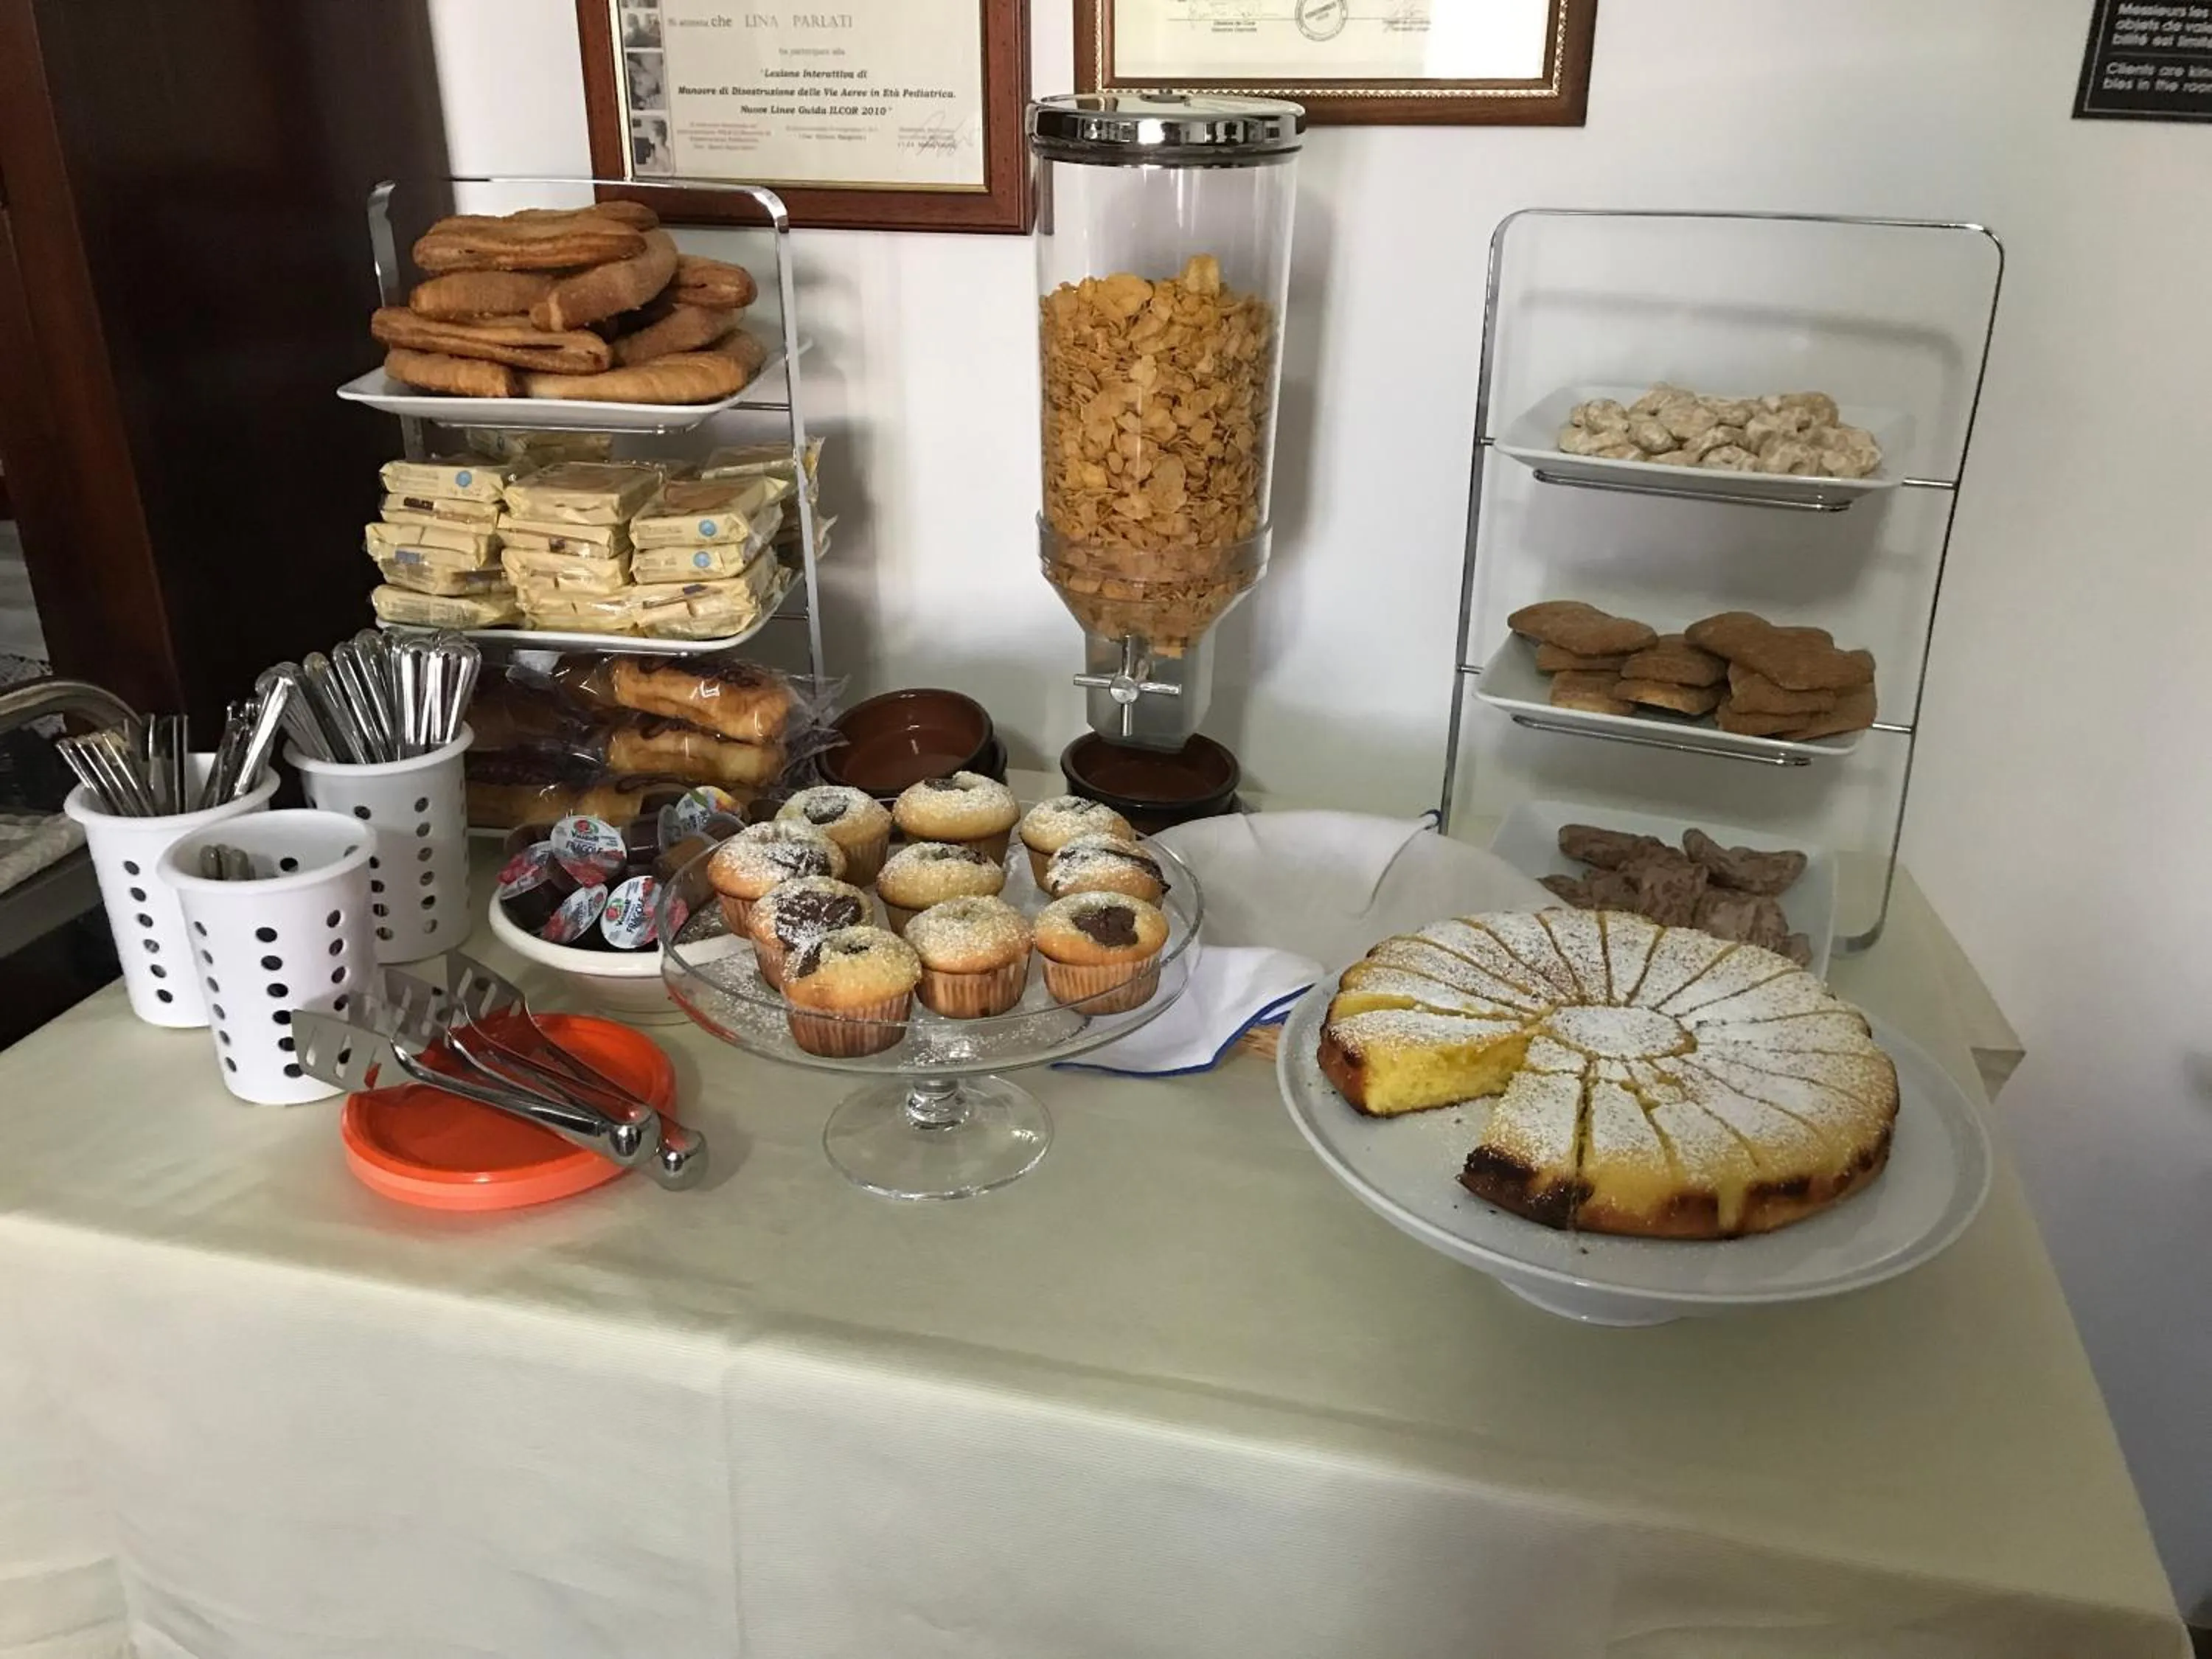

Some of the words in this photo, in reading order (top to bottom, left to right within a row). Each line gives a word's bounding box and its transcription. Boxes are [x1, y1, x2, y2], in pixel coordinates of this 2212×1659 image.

[2188, 6, 2209, 18] les
[710, 15, 732, 27] che
[745, 15, 779, 27] LINA
[793, 15, 852, 28] PARLATI
[2115, 19, 2160, 32] objets
[2161, 20, 2183, 31] de
[2152, 35, 2174, 46] est
[857, 70, 867, 78] di
[2106, 62, 2155, 74] Clients
[2158, 66, 2185, 77] are
[2137, 80, 2151, 91] in
[2155, 79, 2180, 91] the
[719, 86, 729, 95] di
[797, 87, 820, 97] delle
[824, 88, 838, 97] Vie
[841, 88, 868, 97] Aeree
[870, 89, 880, 97] in
[771, 106, 796, 114] Linee
[799, 106, 827, 115] Guida
[830, 106, 859, 115] ILCOR
